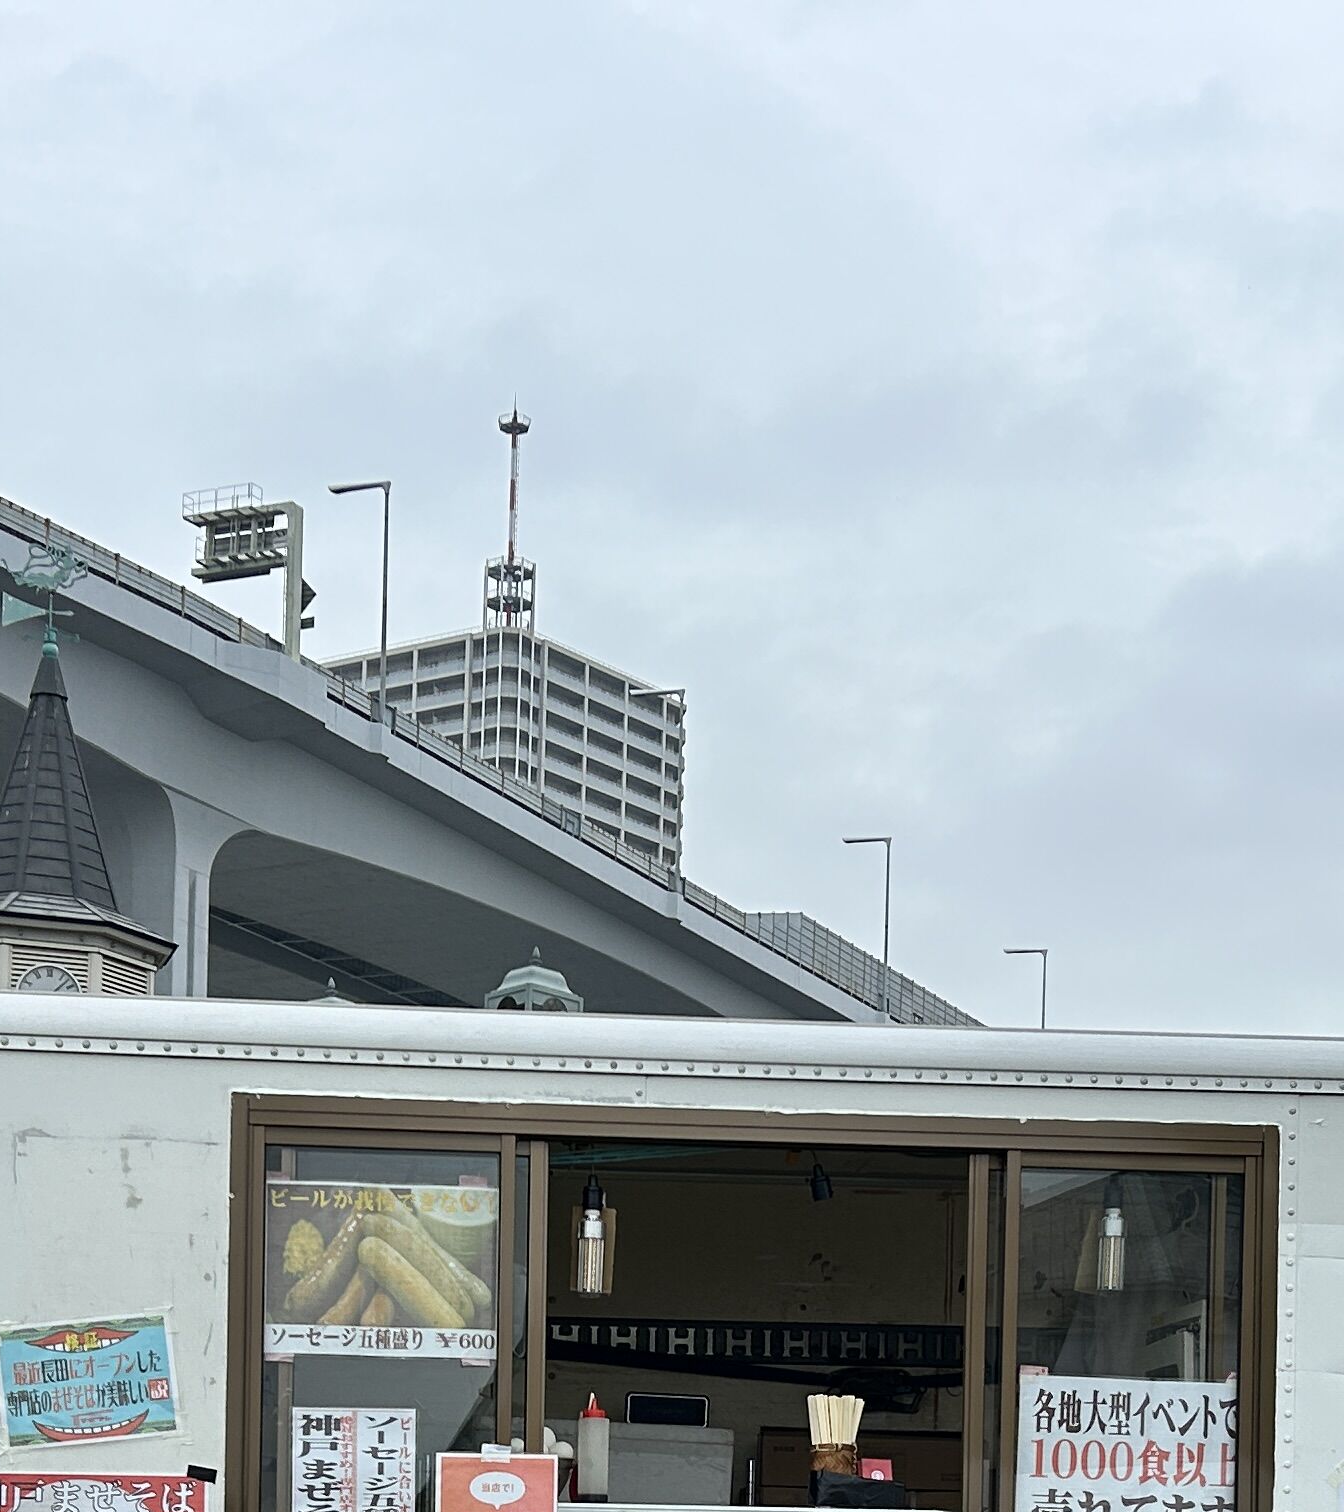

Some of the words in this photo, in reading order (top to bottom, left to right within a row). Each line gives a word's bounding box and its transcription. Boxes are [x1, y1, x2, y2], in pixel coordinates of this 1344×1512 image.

[271, 1328, 423, 1350] ソーセージ五種盛り
[435, 1332, 495, 1350] ¥600
[12, 1350, 163, 1385] 最近長田にオープンした
[1029, 1438, 1236, 1488] 1000食以上
